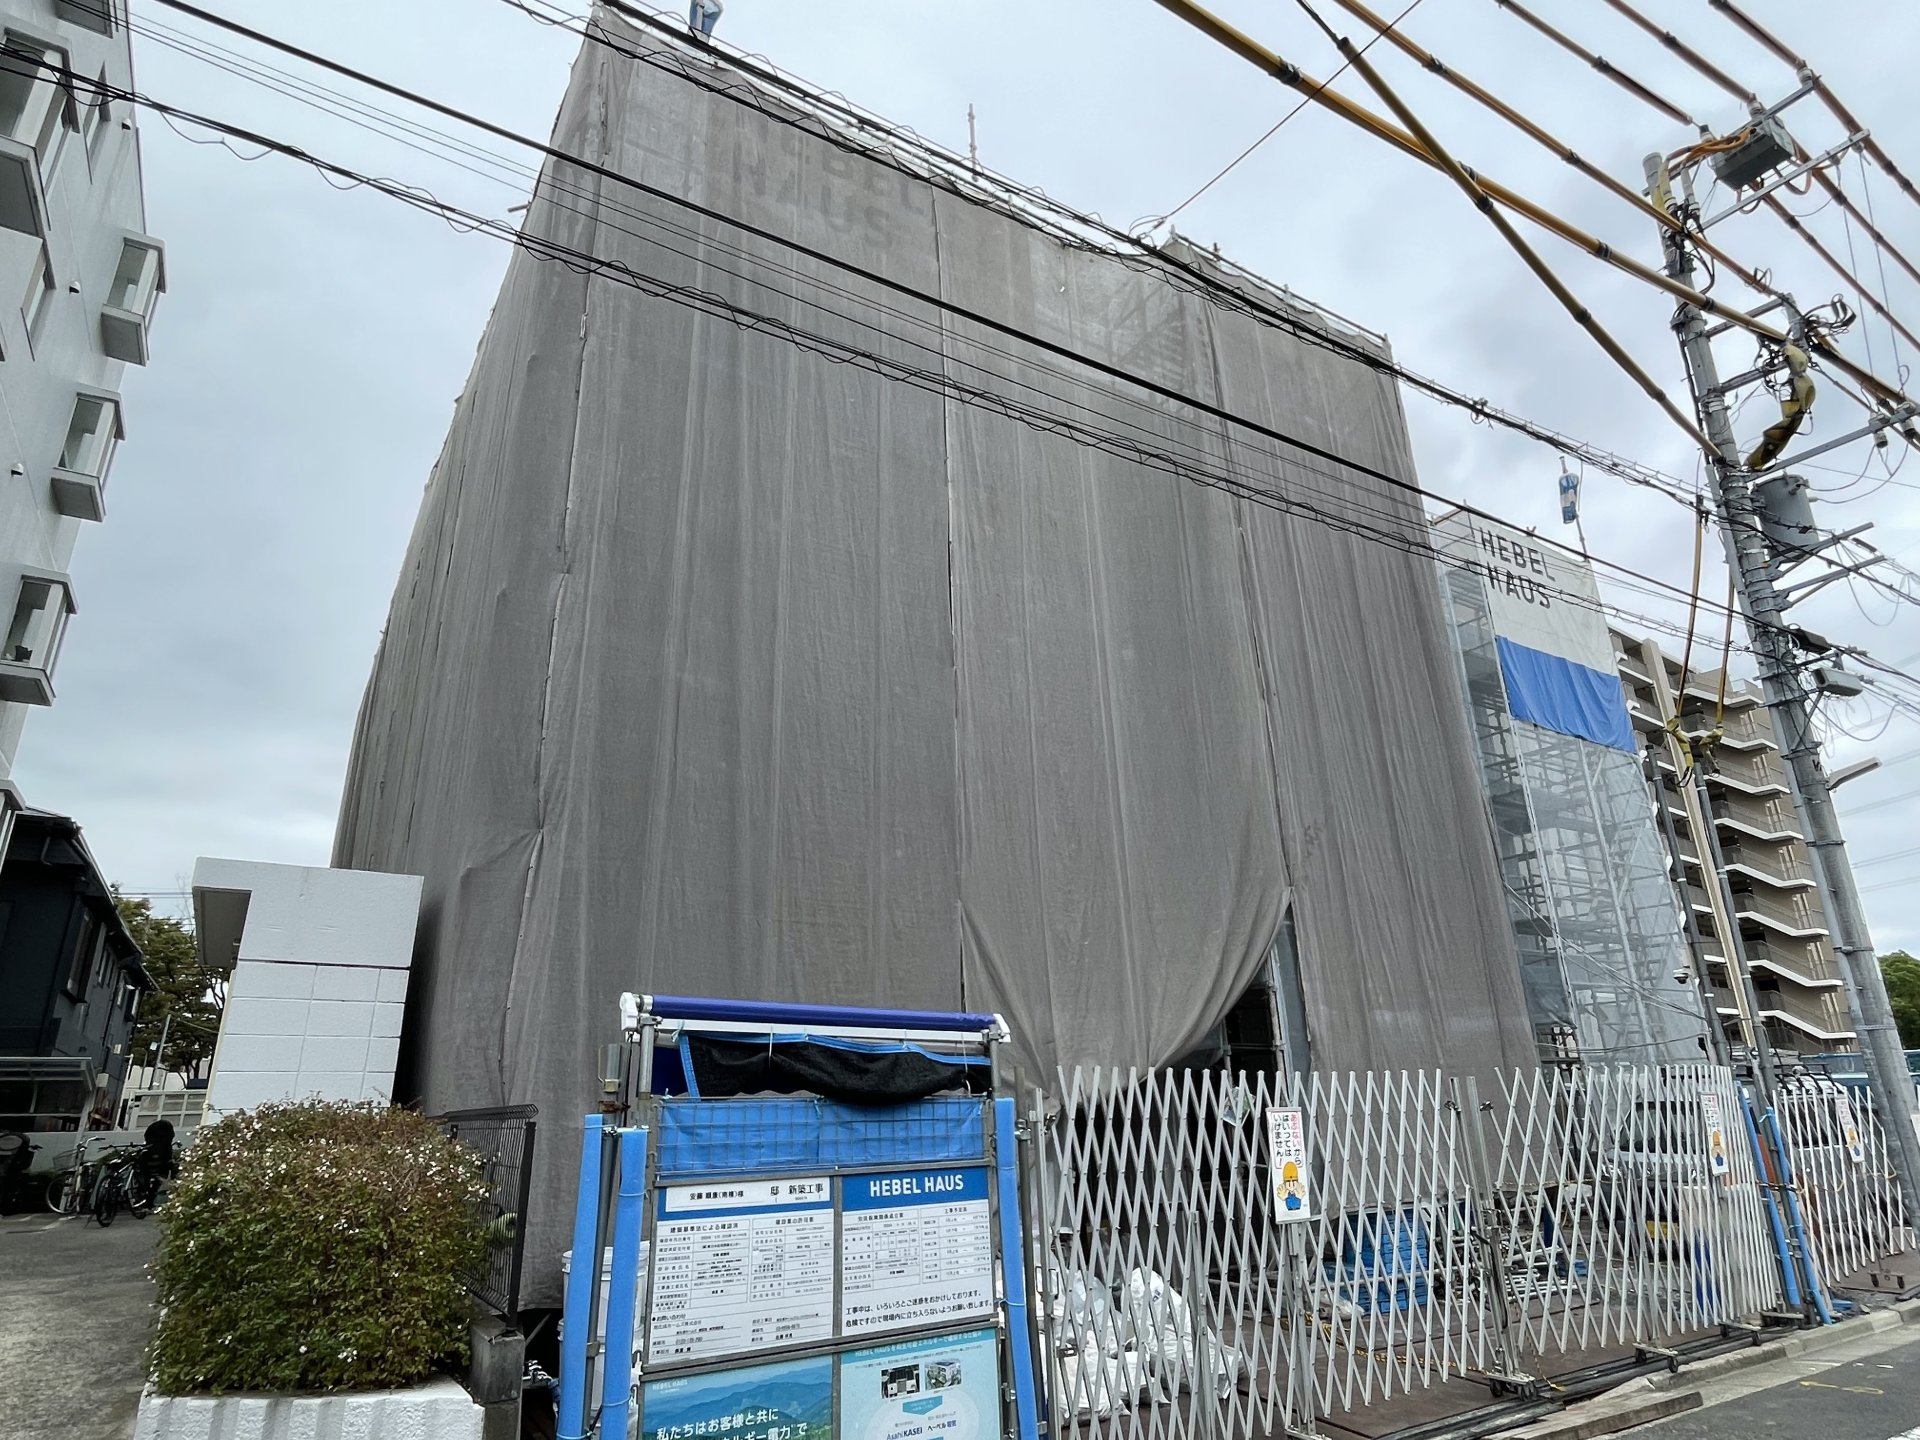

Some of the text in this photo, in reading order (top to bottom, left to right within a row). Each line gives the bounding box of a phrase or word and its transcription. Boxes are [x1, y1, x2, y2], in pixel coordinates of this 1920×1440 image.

[1479, 527, 1556, 582] HEBEL
[1486, 560, 1551, 610] HAUS
[1282, 1114, 1292, 1157] はいっては
[1291, 1113, 1302, 1166] あぶないから
[788, 1183, 824, 1195] 新築工事
[869, 1174, 964, 1198] HEBEL HAUS
[845, 1290, 982, 1315] 工事中は、いろいろとご迷惑をおかけしております。
[845, 1300, 993, 1328] 危険ですので現場内に立ち入らないようお願い致します。
[656, 1408, 779, 1440] 私たちはお客様と共に
